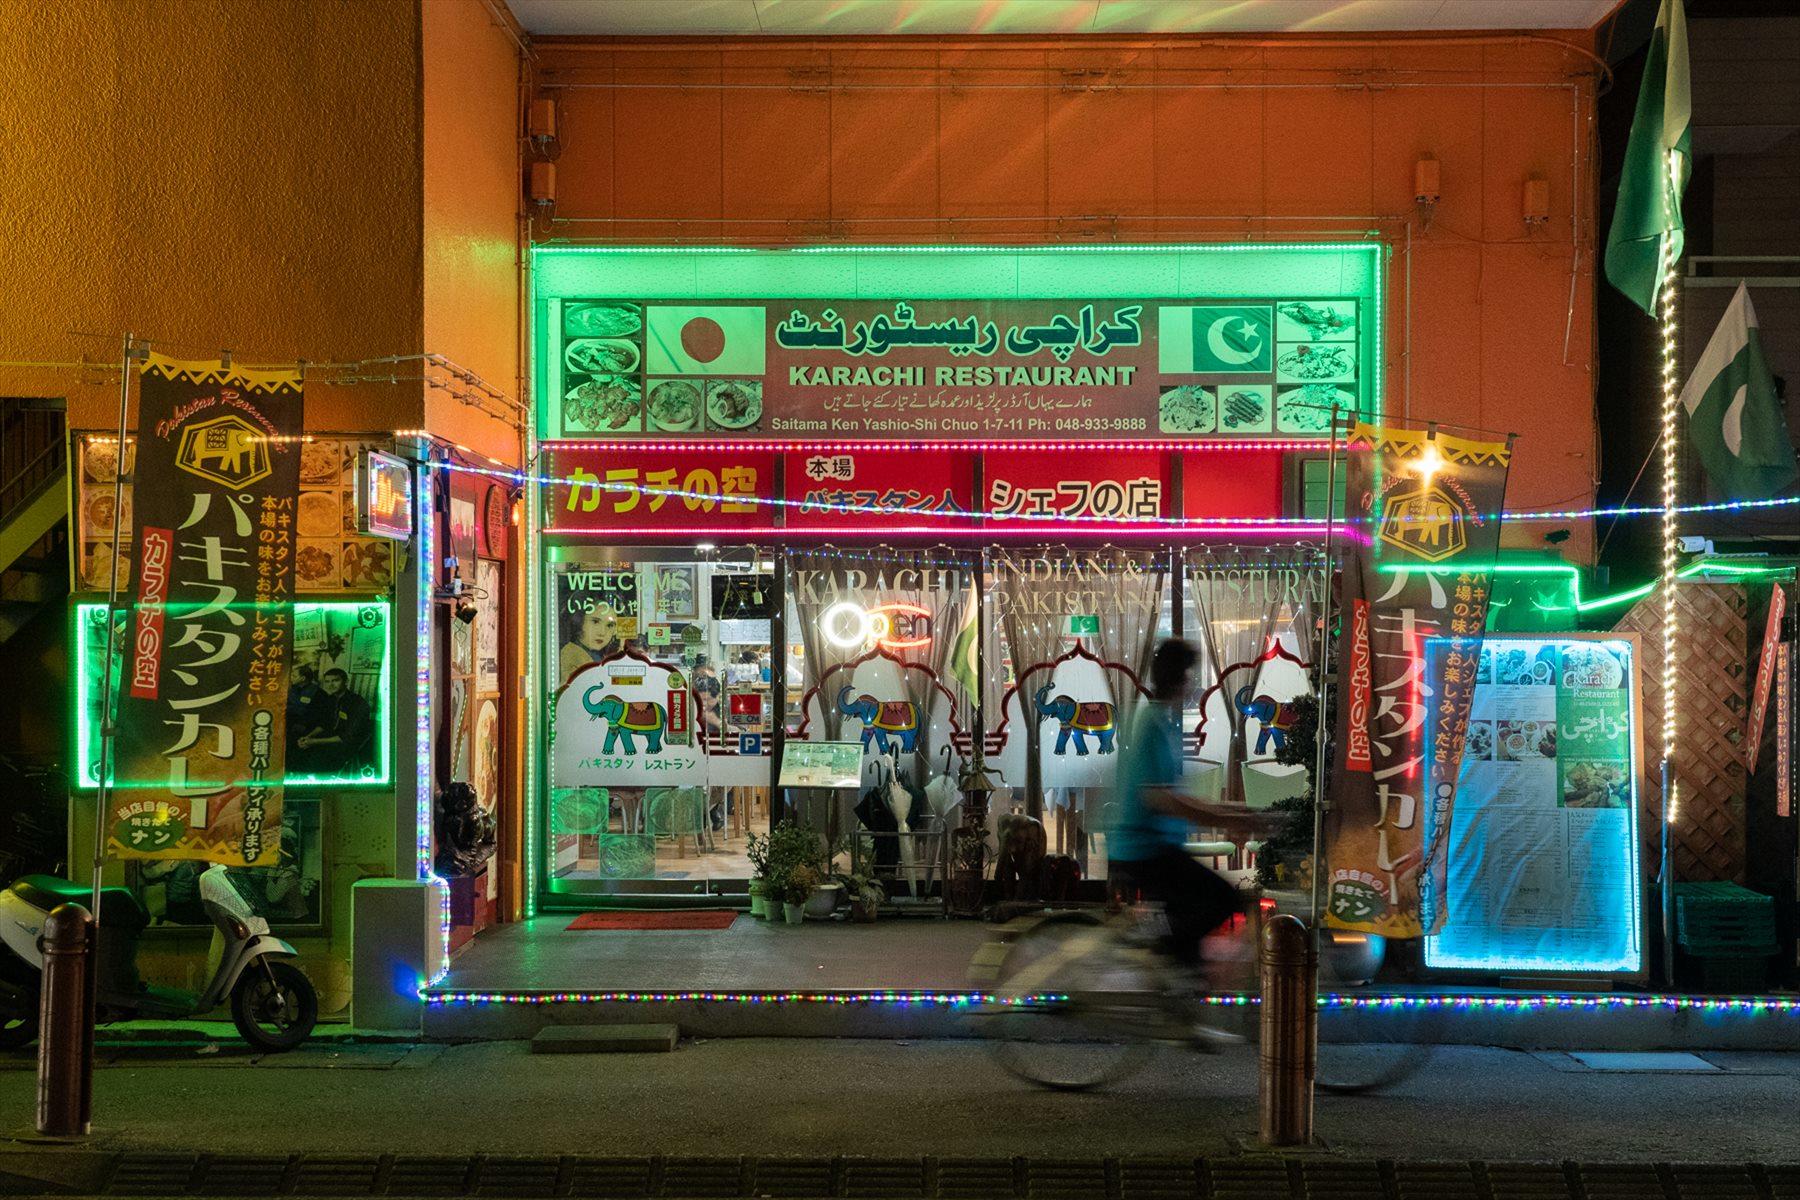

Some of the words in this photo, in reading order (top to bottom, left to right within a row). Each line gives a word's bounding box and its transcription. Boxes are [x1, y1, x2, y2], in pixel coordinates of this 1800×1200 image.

[775, 301, 1000, 357] ریسٹورنٹ
[1005, 304, 1143, 363] کراچی
[788, 366, 927, 387] KARACHI
[935, 366, 1137, 387] RESTAURANT
[771, 418, 828, 431] Saitama
[831, 418, 859, 431] Ken
[863, 418, 937, 431] Yashio-Shi
[941, 418, 979, 431] Chuo
[983, 418, 1023, 431] 1-7-11
[1028, 418, 1051, 431] Ph:
[1055, 418, 1147, 431] 048-933-9888
[805, 455, 856, 482] 本場
[566, 467, 758, 514] カラチの空
[799, 488, 963, 516] パキスタン人
[990, 477, 1161, 522] シェフの店
[991, 559, 1109, 582] INDIAN
[1124, 559, 1144, 582] &
[796, 569, 961, 605] KARACHI
[134, 532, 168, 689] カラチの空
[992, 590, 1163, 615] PAKISTANI
[160, 493, 255, 829] パキスタンカレー
[1573, 686, 1620, 699] Restaurant
[744, 737, 756, 751] P
[645, 758, 696, 770] レストラン
[131, 829, 171, 845] ナン
[1335, 898, 1372, 915] ナン
